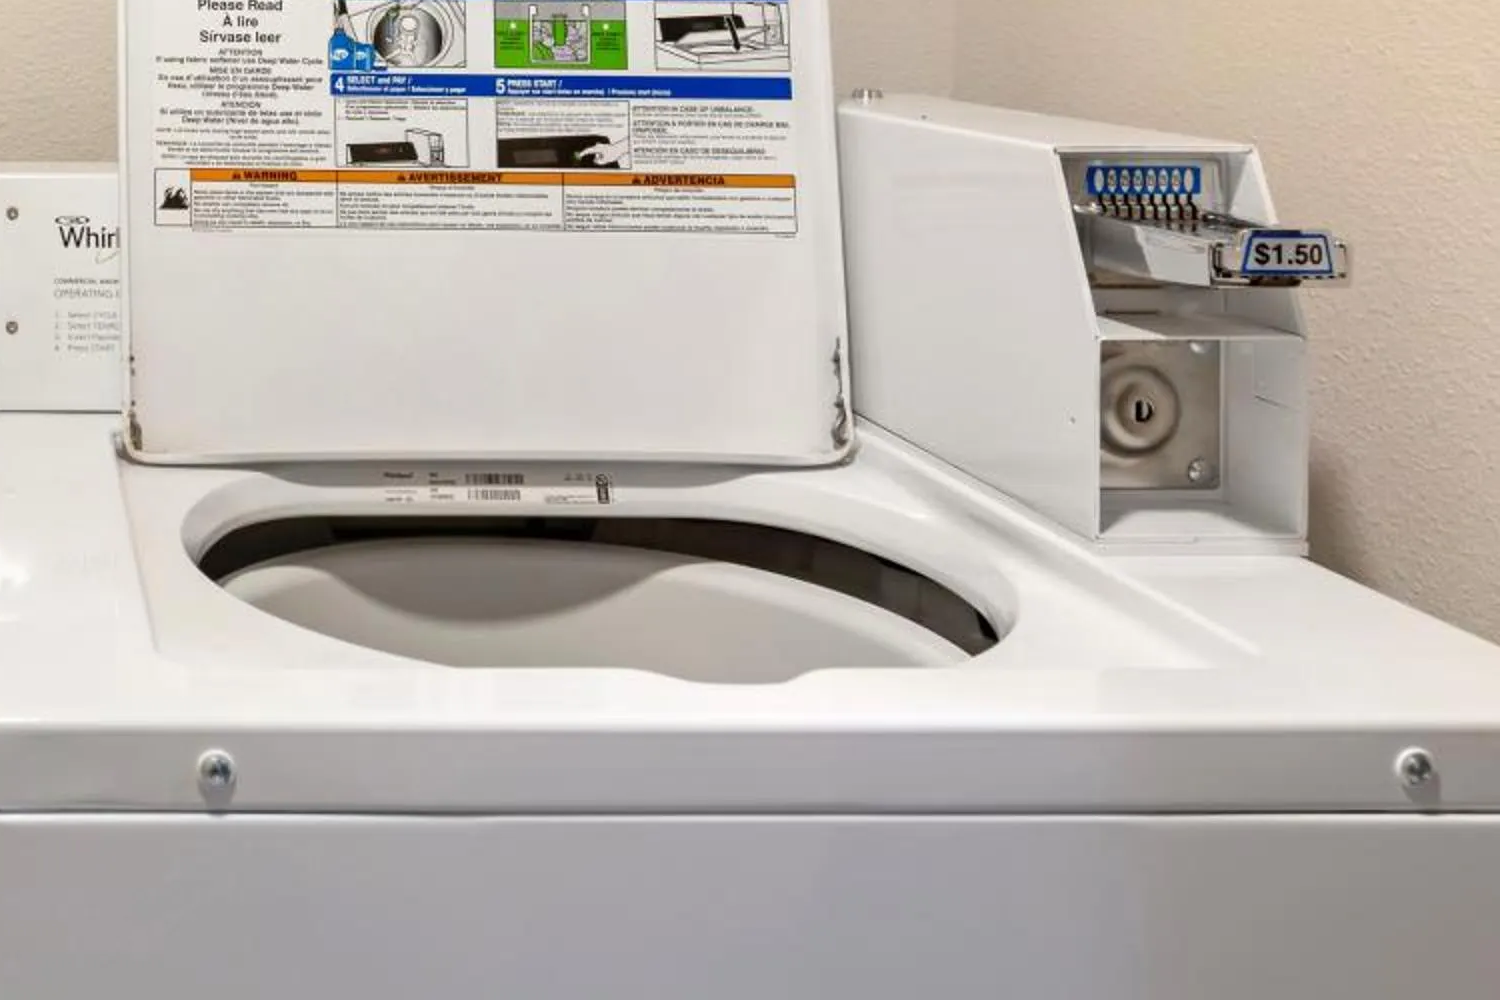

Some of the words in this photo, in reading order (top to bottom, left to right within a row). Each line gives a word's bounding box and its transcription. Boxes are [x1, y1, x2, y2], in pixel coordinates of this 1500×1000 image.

[223, 12, 232, 27] À
[237, 16, 258, 27] lire
[199, 30, 251, 43] Sírvase
[255, 30, 281, 43] leer
[335, 78, 344, 92] 4
[496, 79, 506, 94] 5
[243, 171, 297, 181] WARNING
[409, 173, 502, 183] AVERTISSEMENT
[644, 176, 725, 185] ADVERTENCIA
[59, 226, 121, 248] Whirl
[1254, 243, 1323, 268] $1.50
